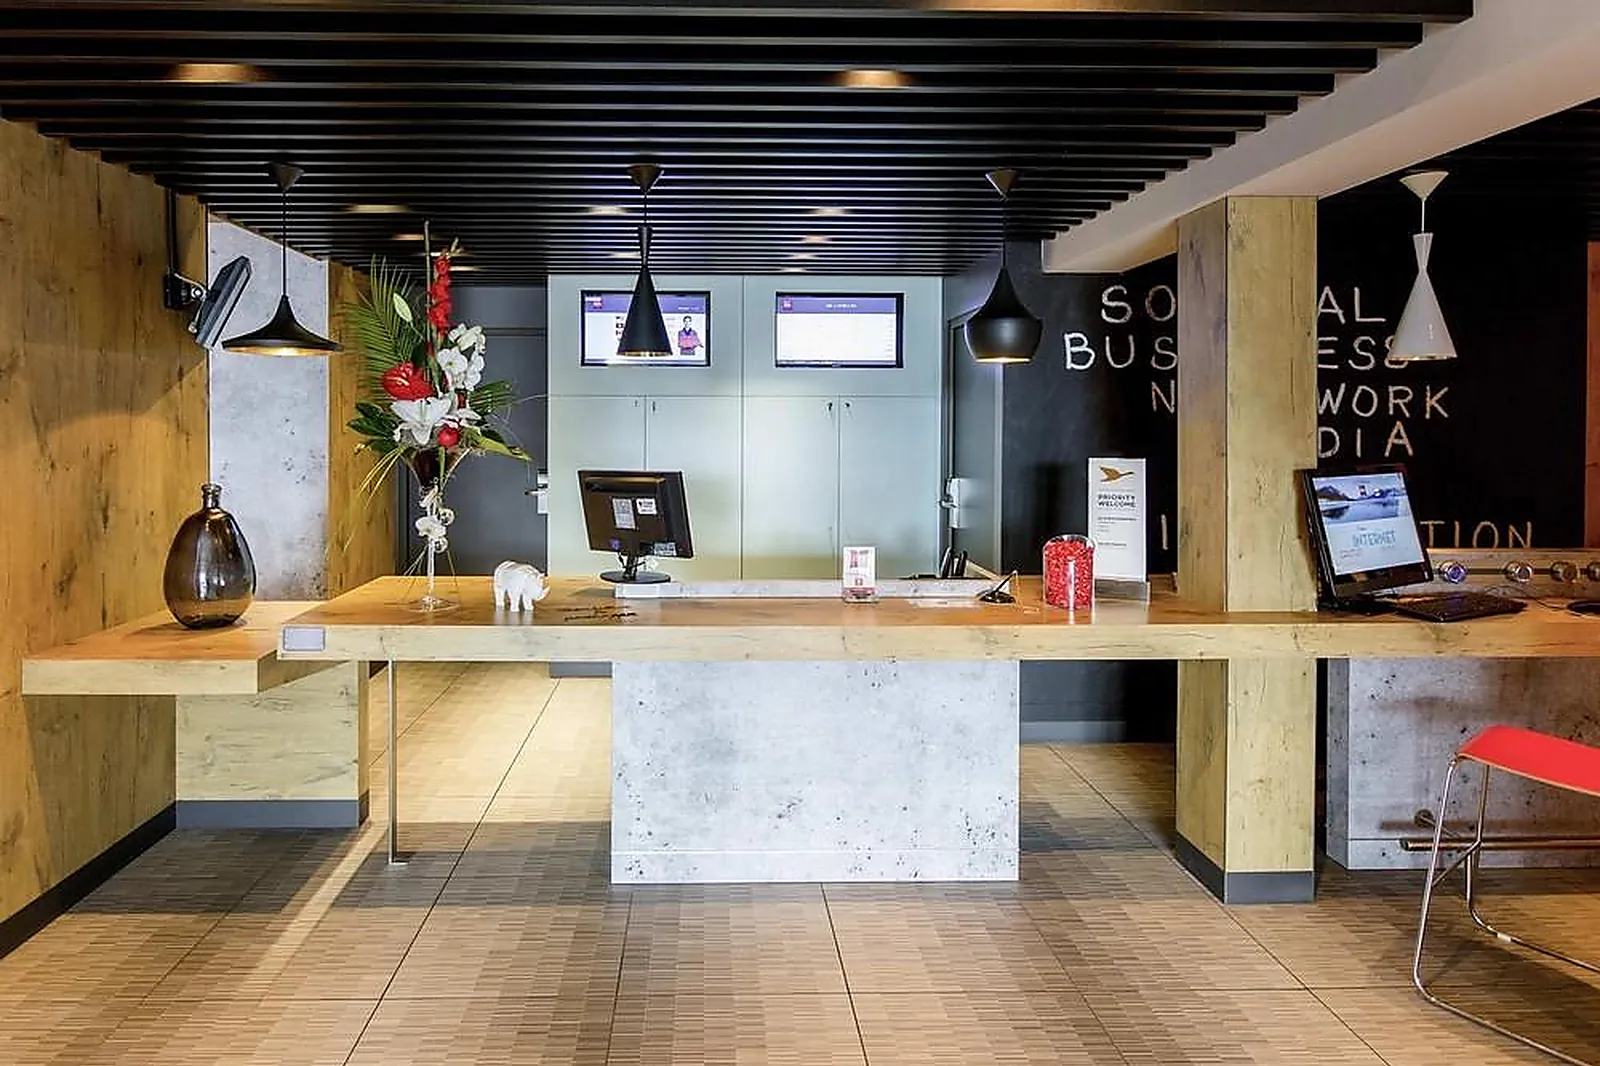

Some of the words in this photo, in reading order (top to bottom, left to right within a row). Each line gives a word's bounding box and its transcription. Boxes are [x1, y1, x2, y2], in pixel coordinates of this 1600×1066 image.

[1318, 420, 1413, 458] DIA
[1098, 500, 1136, 508] WELCOME
[1352, 529, 1396, 547] INTERNET
